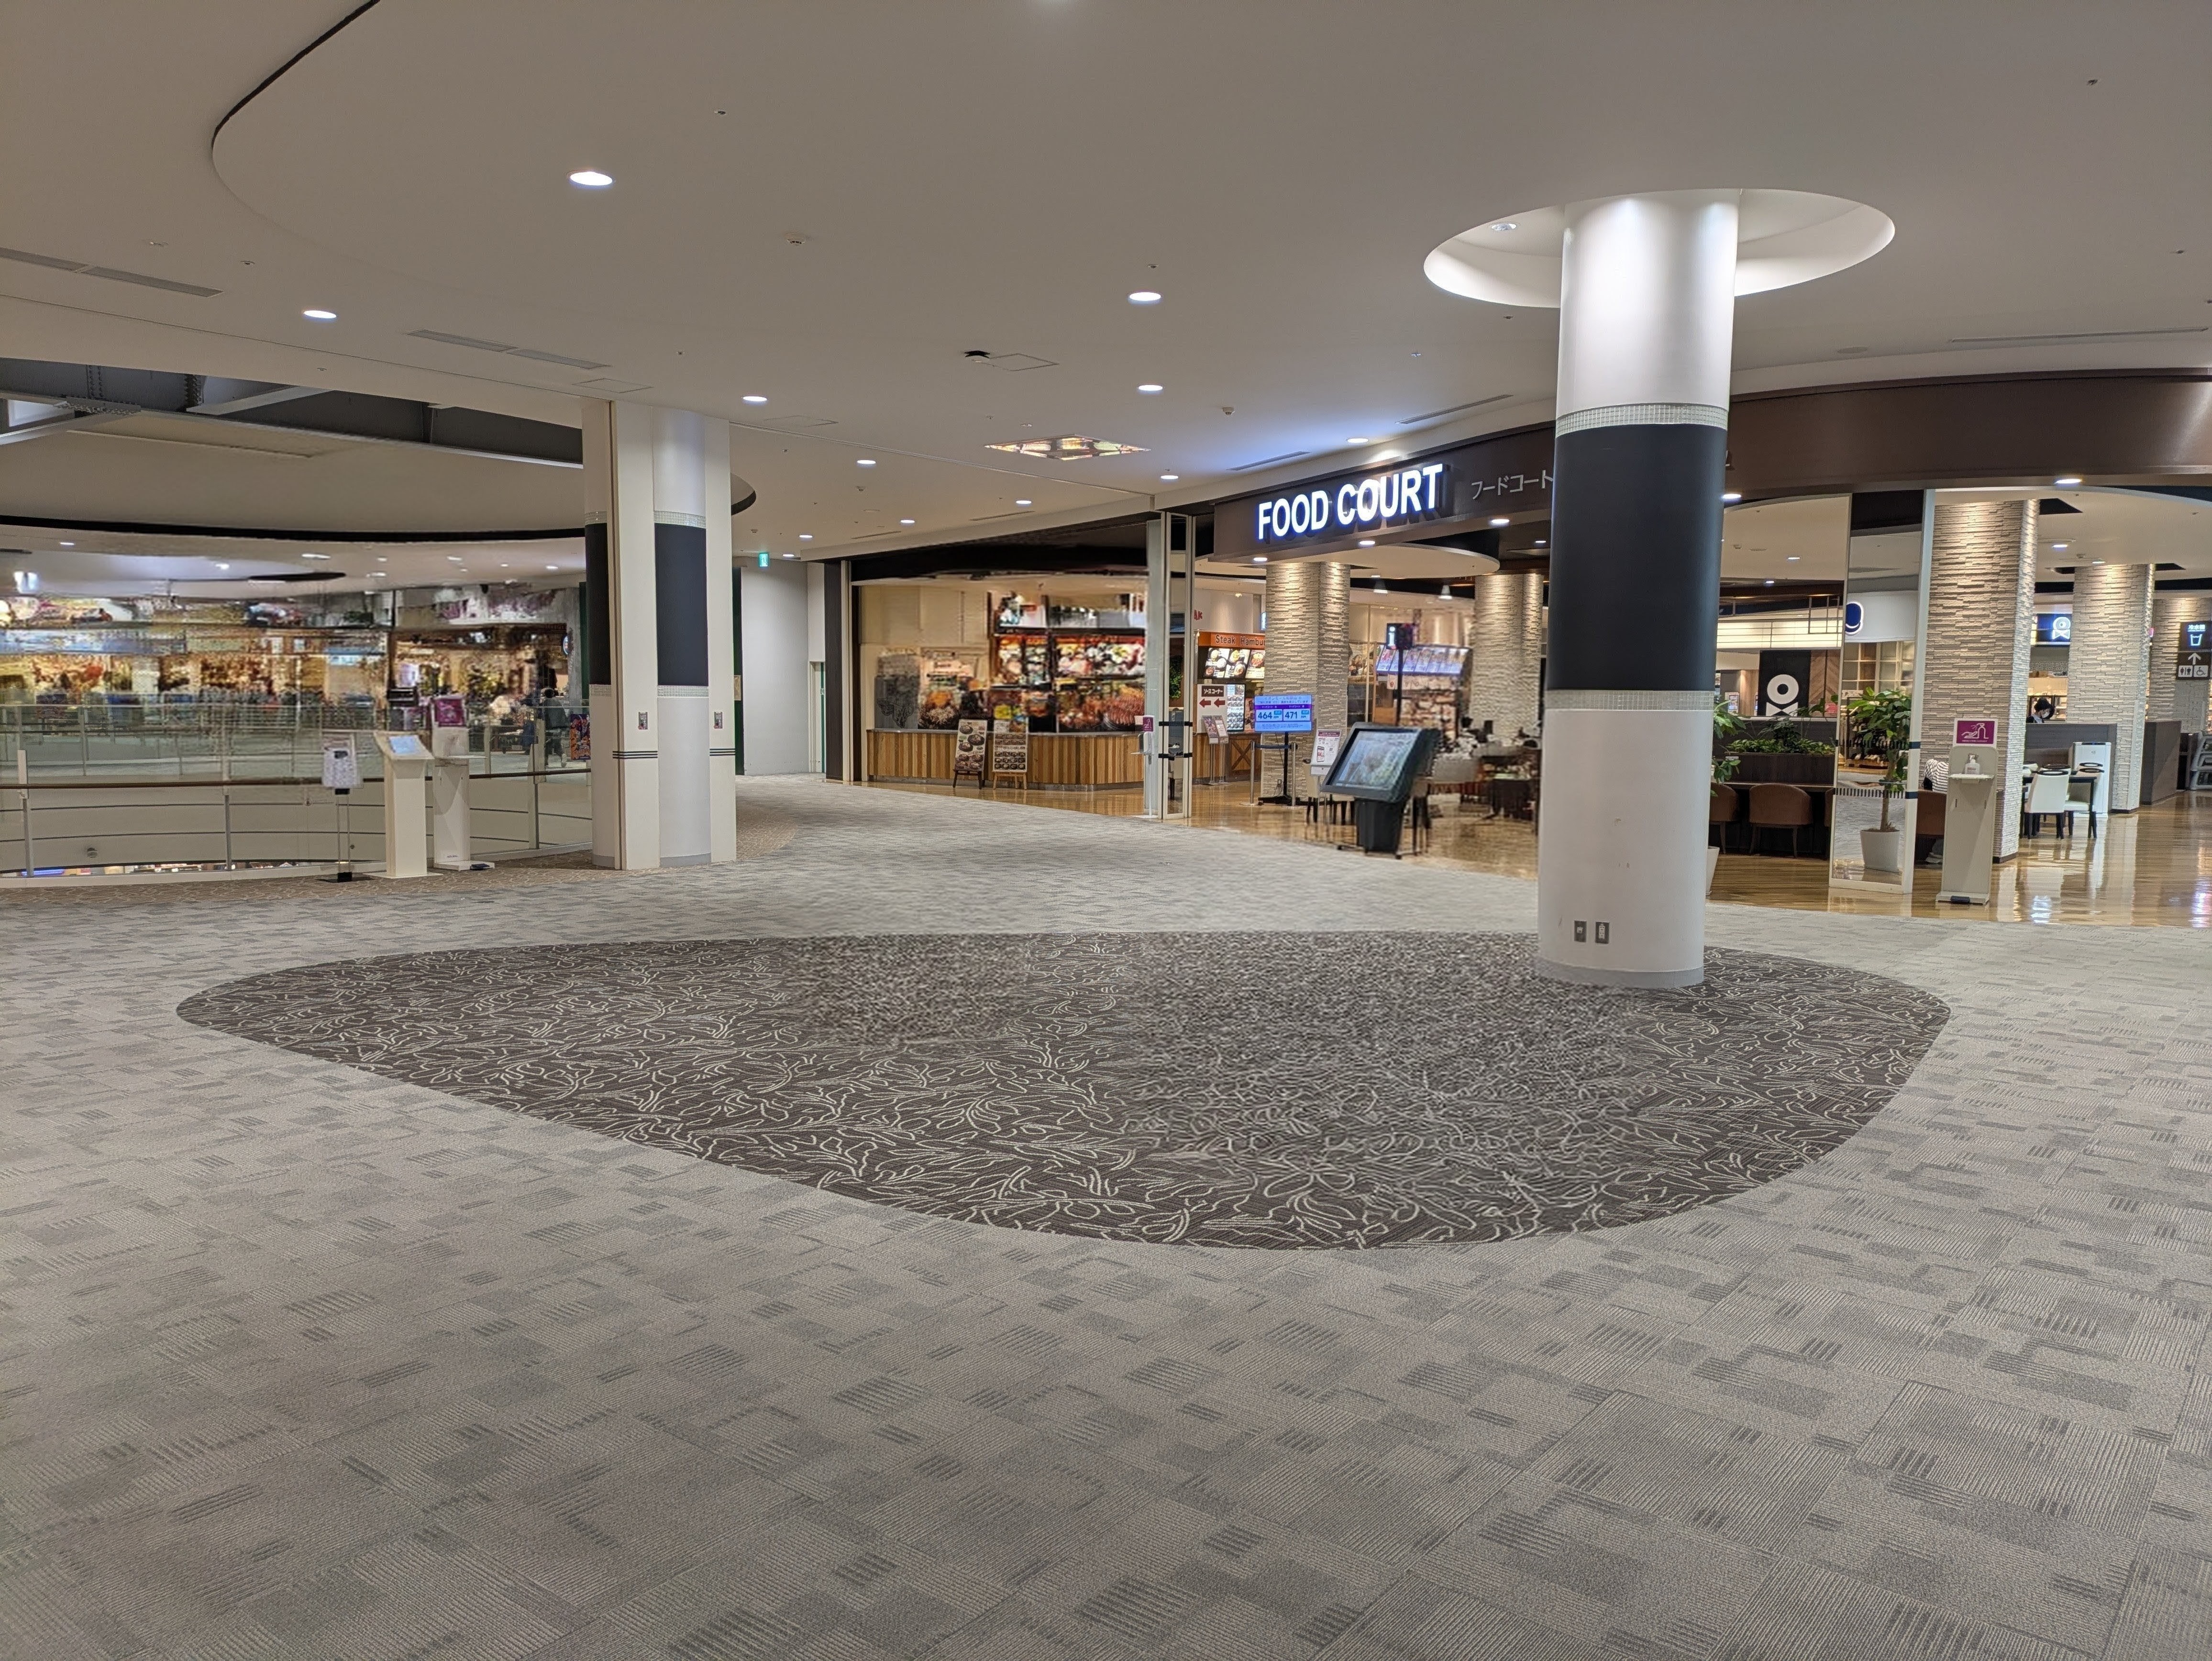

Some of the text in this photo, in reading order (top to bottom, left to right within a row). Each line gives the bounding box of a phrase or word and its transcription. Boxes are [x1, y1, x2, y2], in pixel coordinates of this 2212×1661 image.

[1471, 470, 1553, 500] フードコート
[1258, 463, 1443, 540] FOOD COURT
[1216, 634, 1236, 644] Steak
